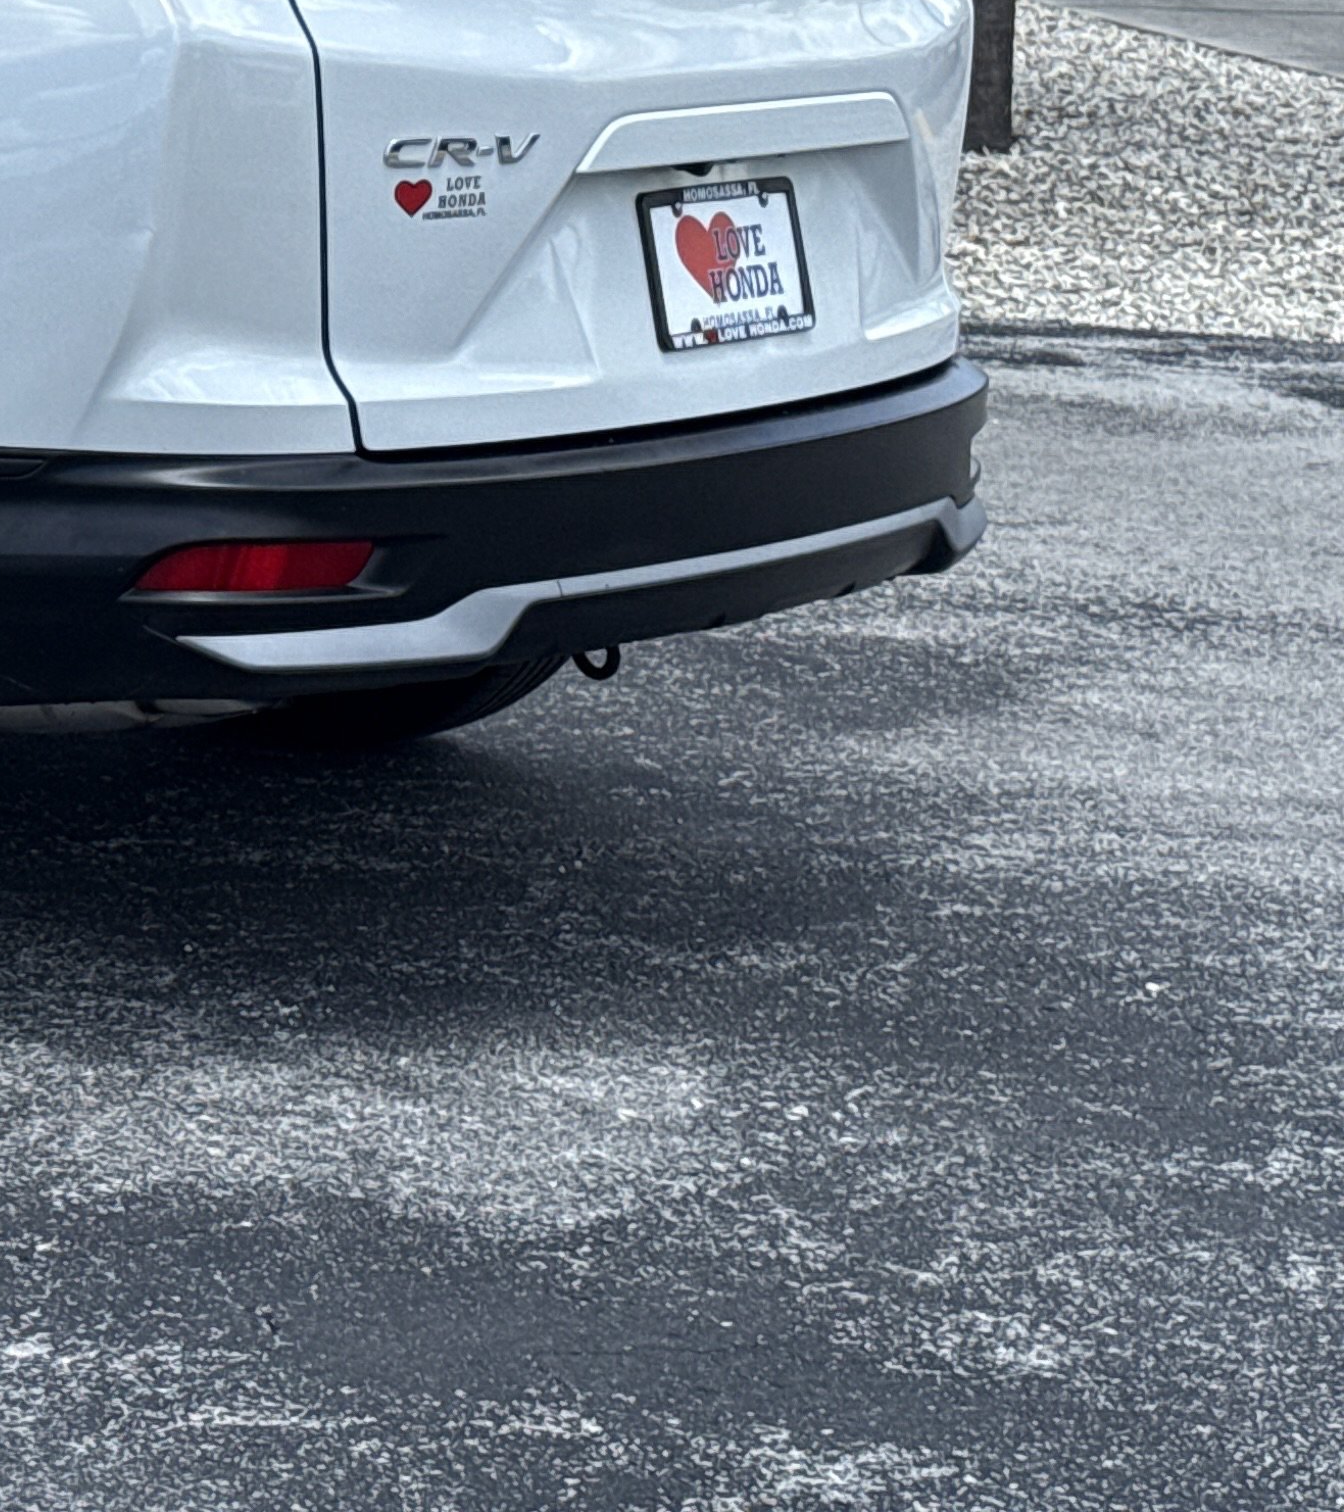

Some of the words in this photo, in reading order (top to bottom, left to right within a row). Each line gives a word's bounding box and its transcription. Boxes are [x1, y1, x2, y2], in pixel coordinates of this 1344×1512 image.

[383, 132, 541, 169] CR-V
[438, 192, 486, 208] HONDA
[446, 175, 482, 191] LOVE
[713, 223, 766, 261] LOVE
[710, 262, 784, 304] HONDA
